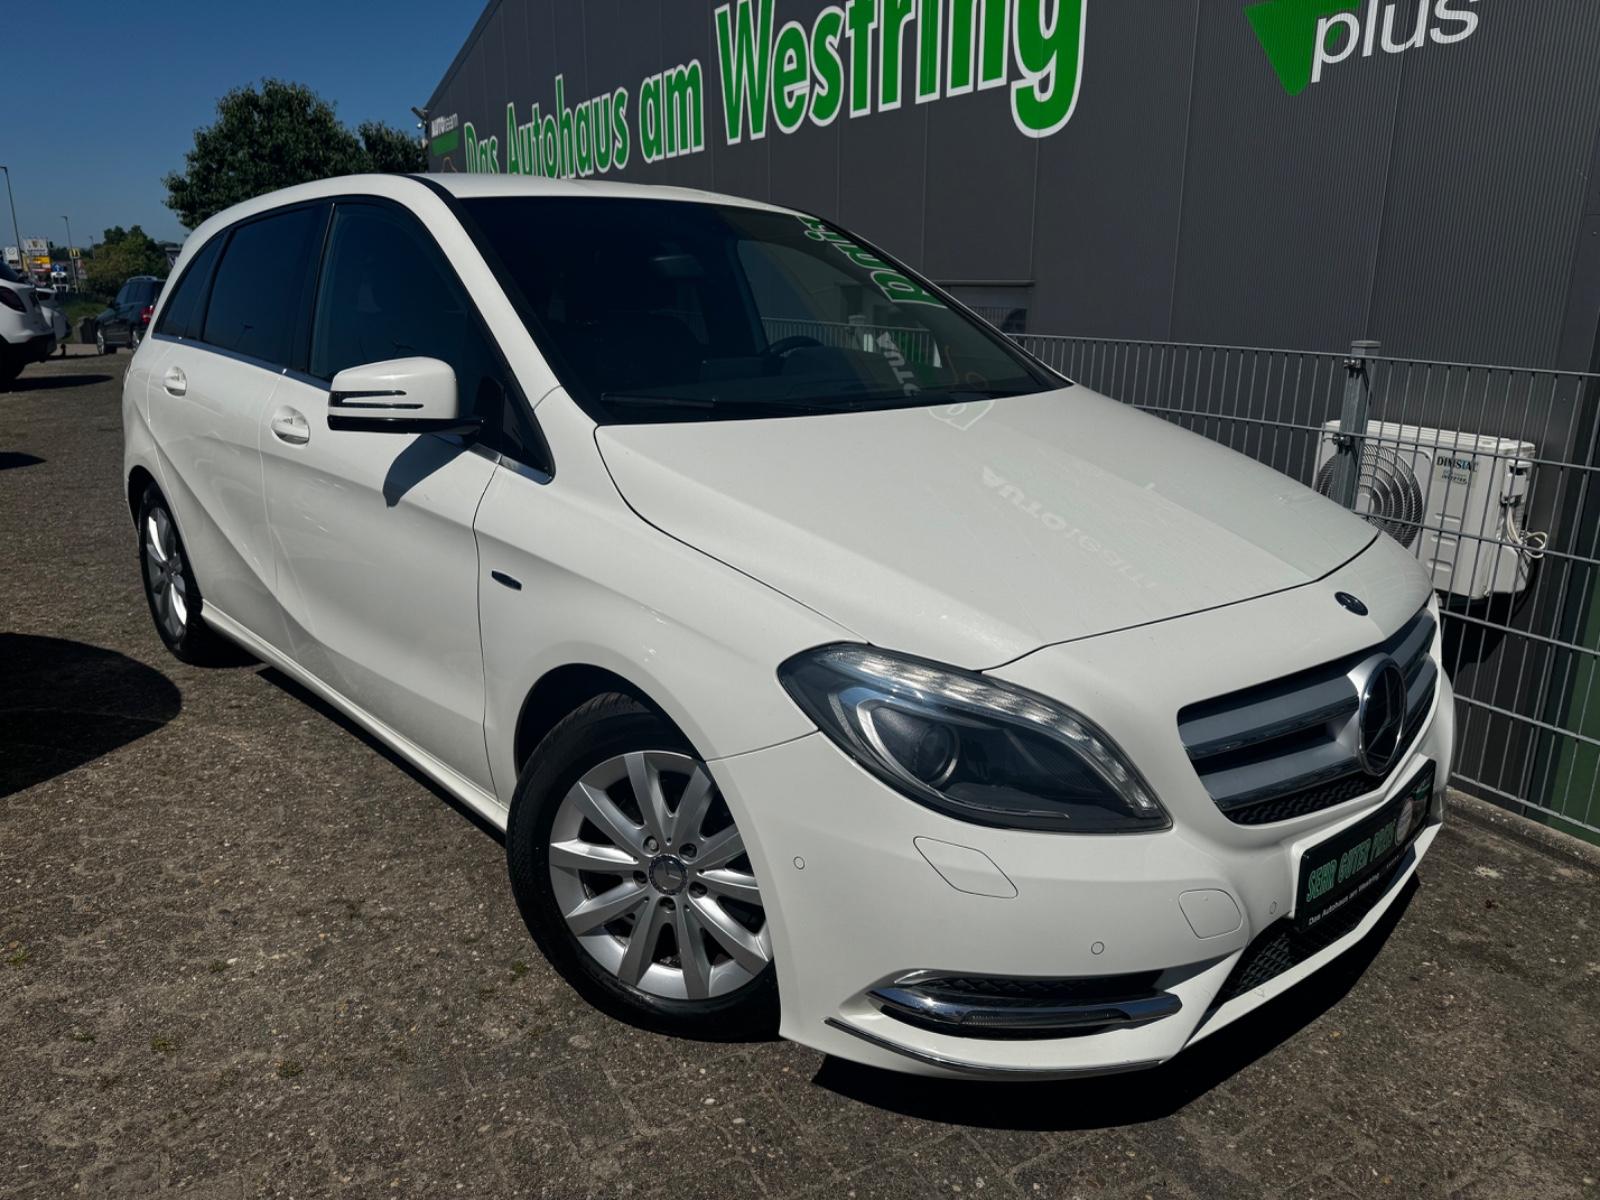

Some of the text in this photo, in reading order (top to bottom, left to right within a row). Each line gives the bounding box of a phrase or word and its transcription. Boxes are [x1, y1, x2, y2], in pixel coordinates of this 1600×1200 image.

[464, 0, 1087, 180] Das Autohaus am Westring
[1311, 0, 1479, 83] plus
